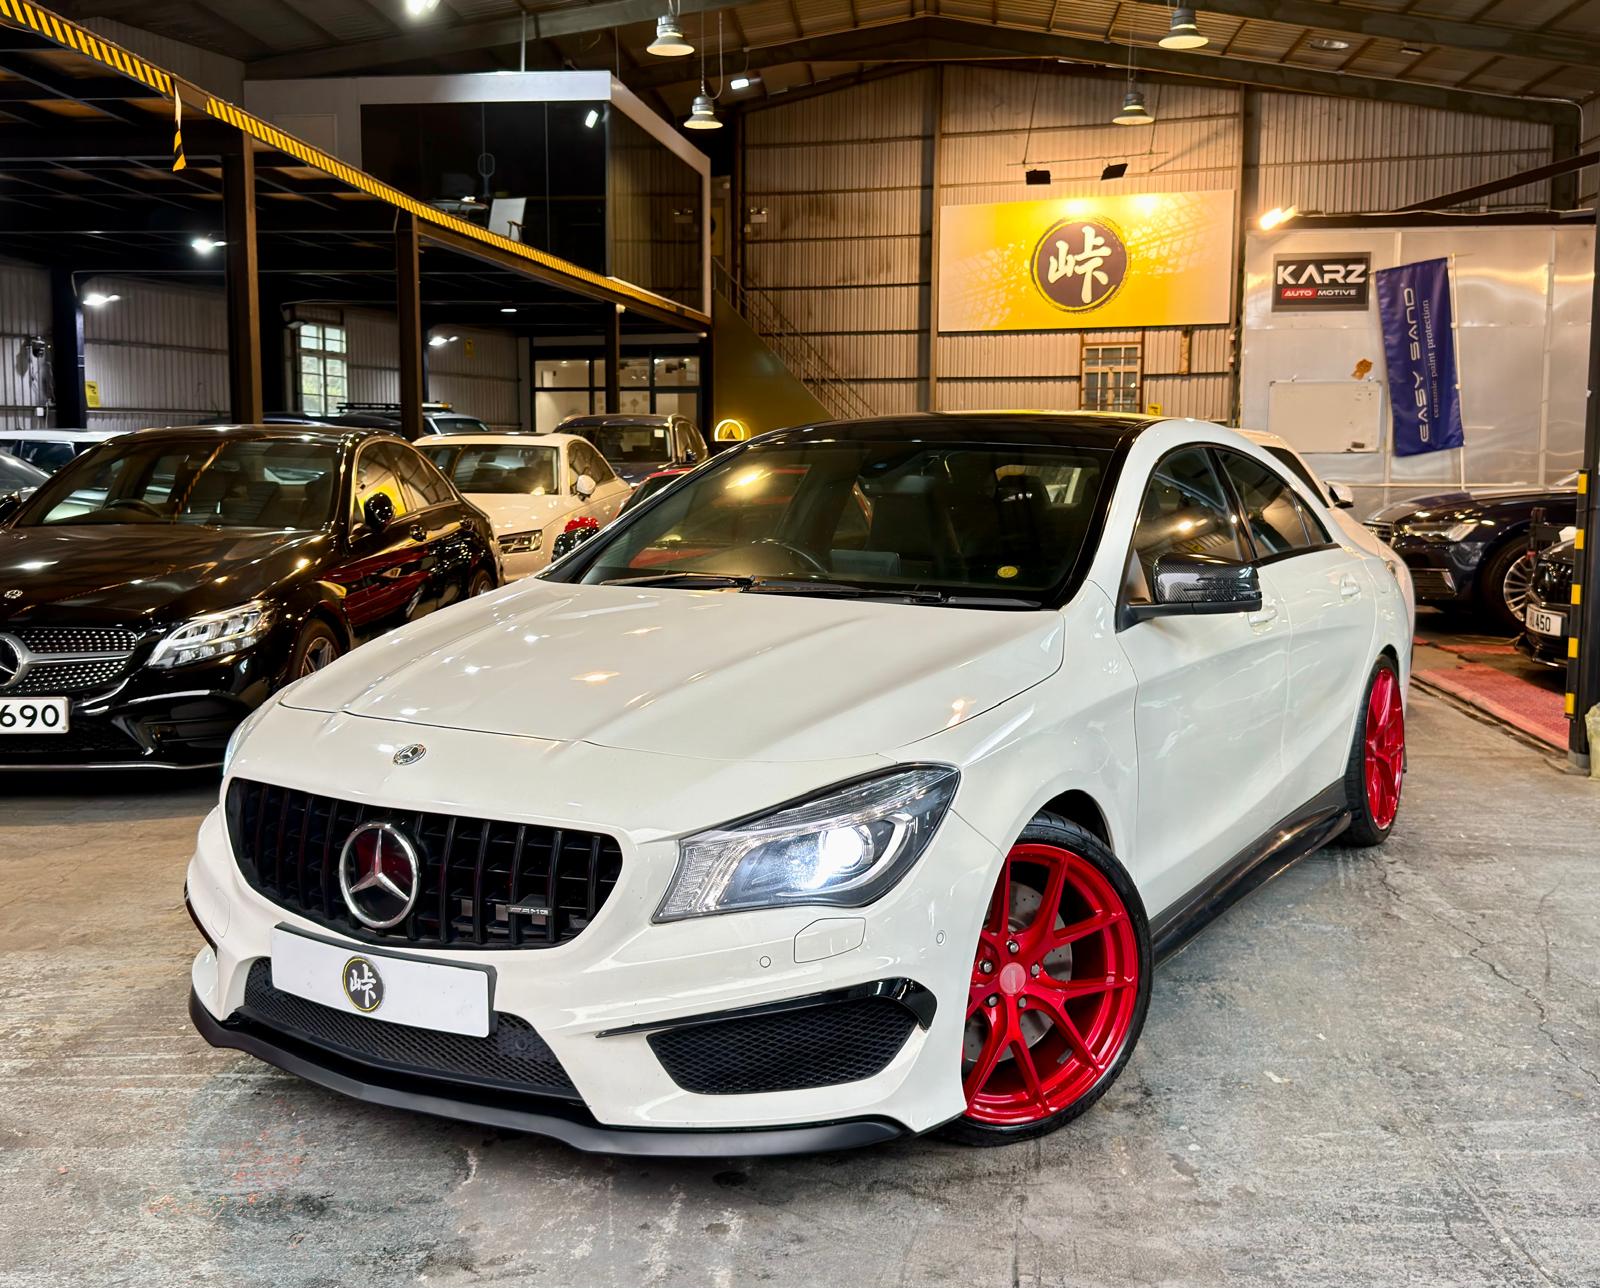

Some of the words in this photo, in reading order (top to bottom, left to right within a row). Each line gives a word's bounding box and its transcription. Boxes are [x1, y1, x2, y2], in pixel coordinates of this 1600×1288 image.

[1048, 225, 1112, 304] 峠
[1276, 264, 1366, 285] KARZ
[1284, 289, 1313, 297] AUTO
[1403, 287, 1421, 361] SAND
[1422, 299, 1436, 349] protection
[1427, 352, 1438, 377] paint
[1412, 370, 1430, 443] EASY
[1432, 380, 1440, 418] ceramic
[0, 704, 60, 728] 690
[349, 963, 377, 1007] 峠
